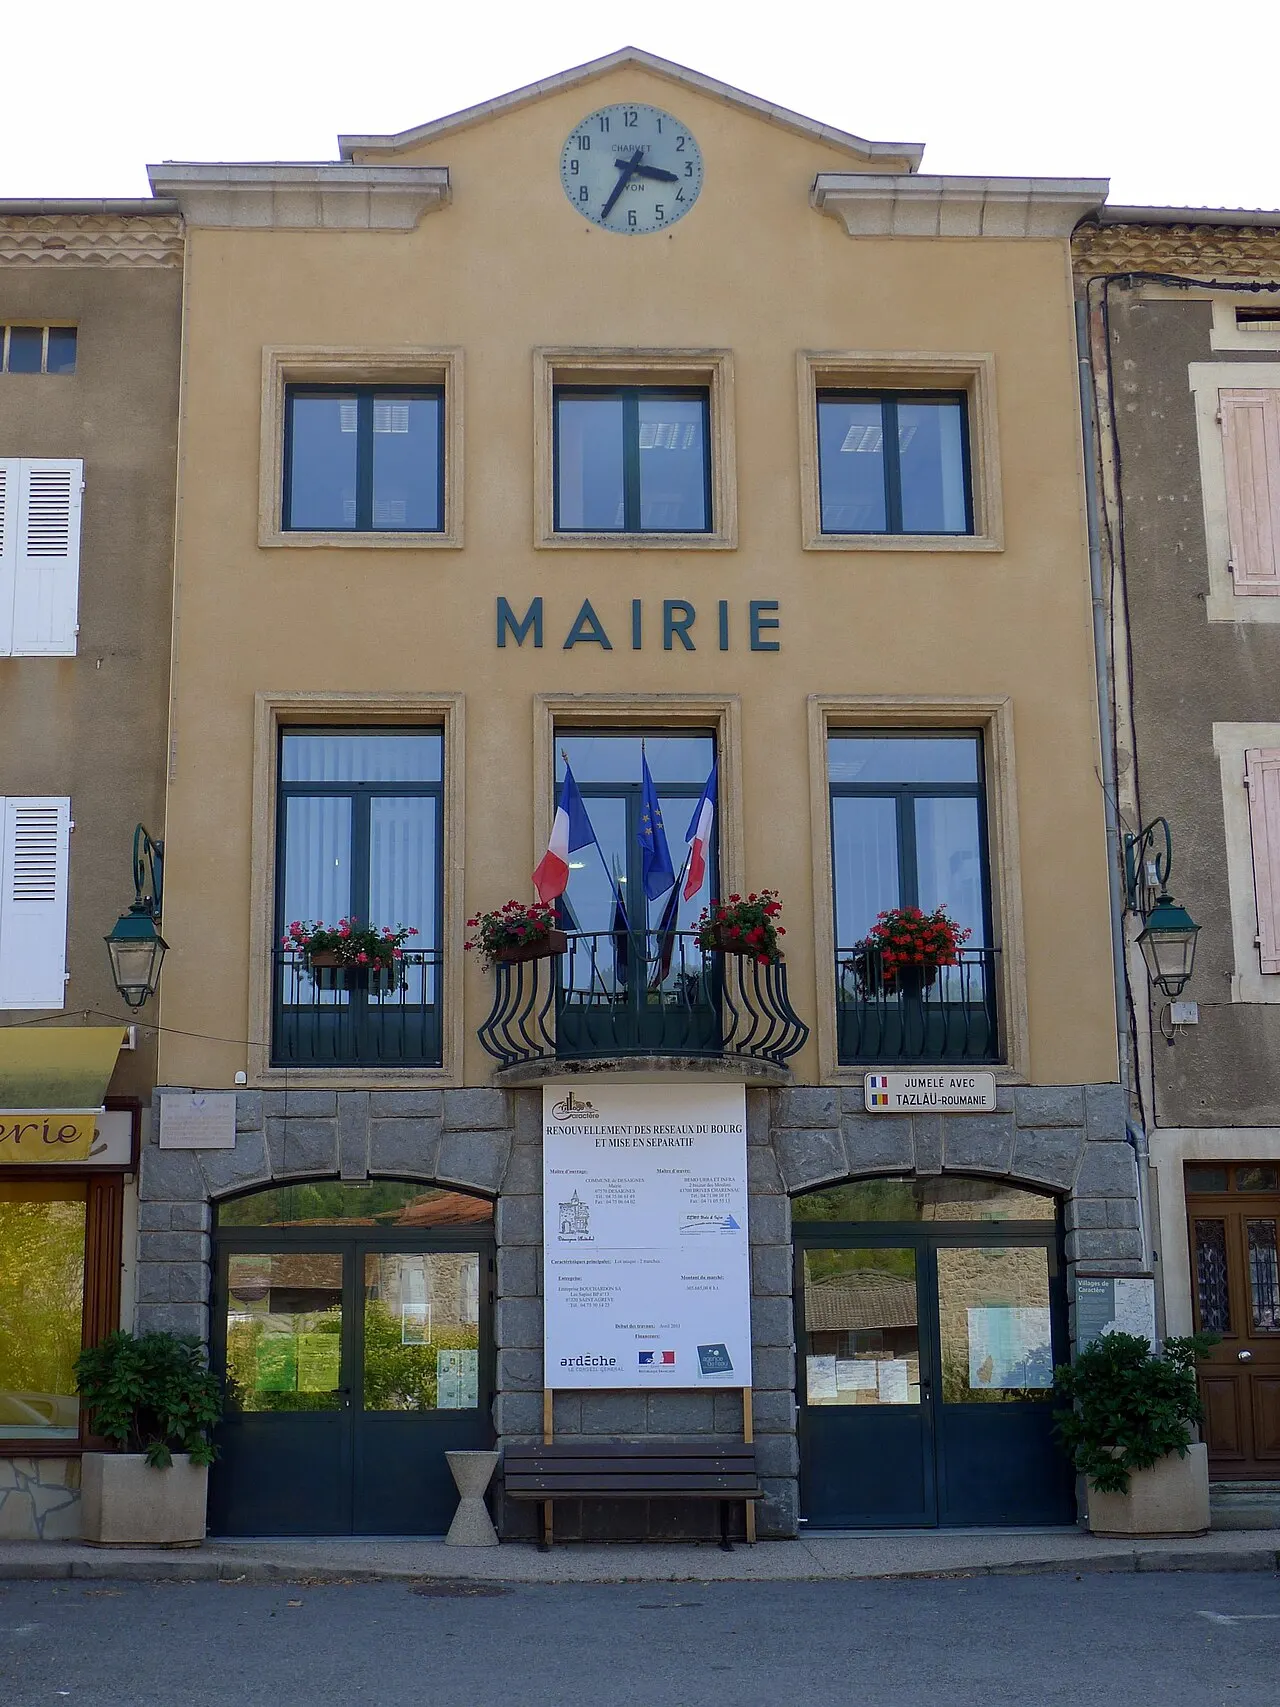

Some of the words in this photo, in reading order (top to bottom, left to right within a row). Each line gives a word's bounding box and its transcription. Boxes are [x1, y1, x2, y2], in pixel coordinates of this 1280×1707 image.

[600, 117, 609, 132] 11
[623, 111, 638, 127] 12
[656, 118, 662, 134] 1
[577, 135, 590, 150] 10
[676, 136, 685, 152] 2
[570, 159, 579, 175] 9
[684, 161, 693, 177] 3
[579, 186, 588, 201] 8
[675, 187, 685, 202] 4
[628, 210, 637, 226] 6
[655, 204, 664, 220] 5
[497, 597, 780, 651] MAIRIE
[905, 1077, 944, 1088] JUMELÉ
[950, 1079, 975, 1088] AVEC
[0, 1117, 83, 1144] rie
[546, 1125, 632, 1136] RENOUVELLEMENT
[634, 1125, 651, 1135] DES
[653, 1124, 694, 1134] RESEAUX
[696, 1124, 709, 1134] DU
[711, 1124, 743, 1134] BOURG
[595, 1138, 606, 1148] ET
[608, 1138, 631, 1148] MISE
[633, 1137, 645, 1147] EN
[646, 1137, 695, 1147] SEPARATIF
